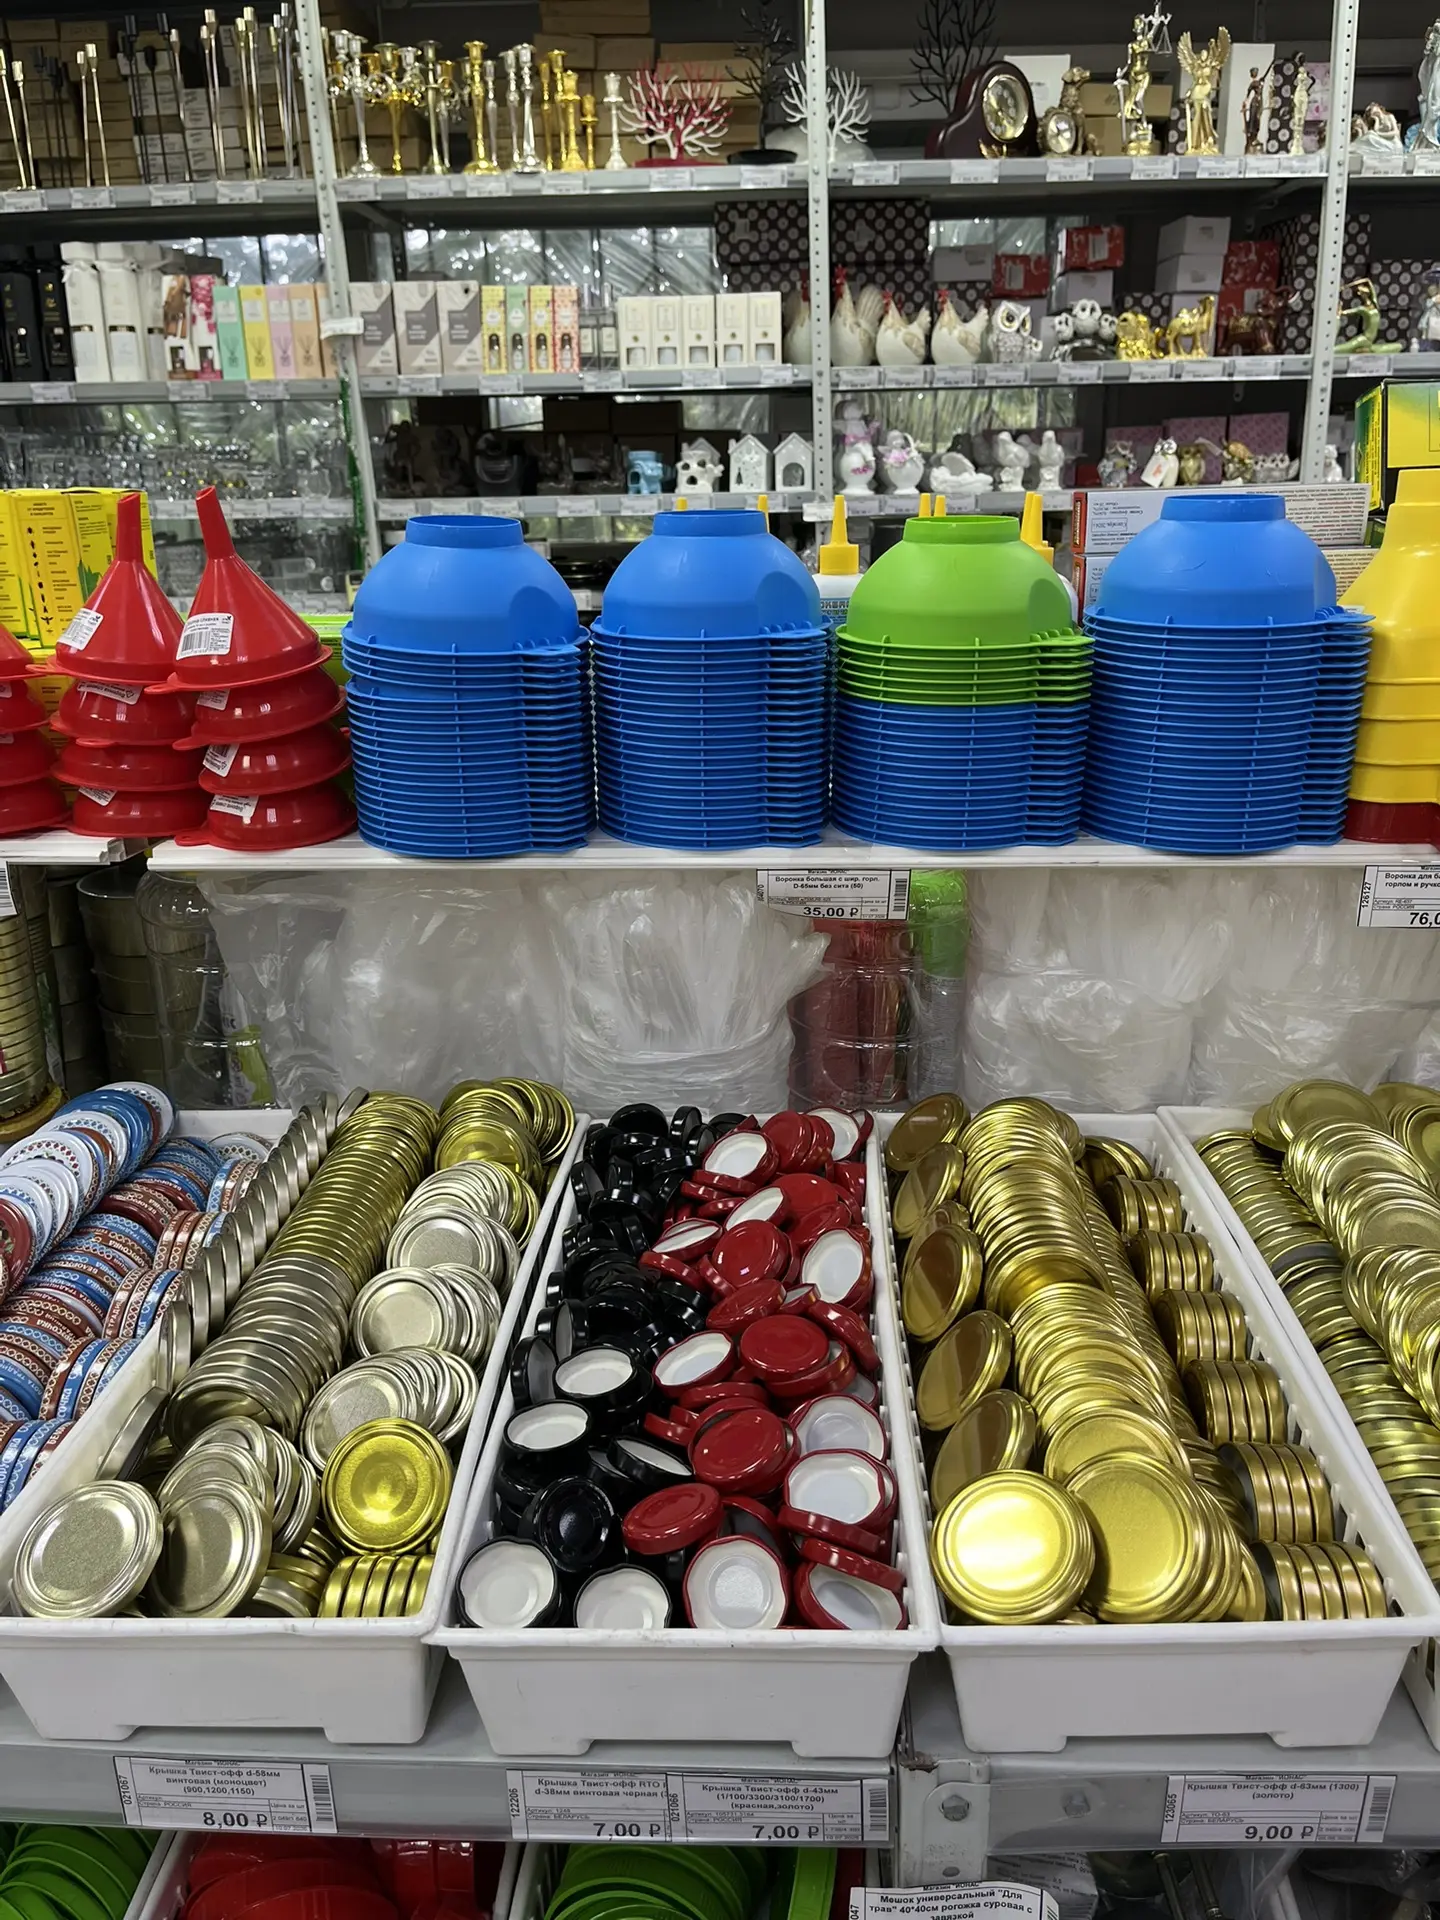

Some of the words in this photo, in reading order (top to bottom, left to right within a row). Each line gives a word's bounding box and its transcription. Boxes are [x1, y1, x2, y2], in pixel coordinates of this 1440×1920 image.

[775, 875, 805, 883] Воронка
[1361, 881, 1372, 909] 126127
[803, 906, 845, 918] 35,00
[78, 1292, 104, 1318] ТЕПЛОТА
[148, 1766, 187, 1775] Крышка
[190, 1768, 244, 1778] Твист-офф
[246, 1769, 281, 1778] d-58мм
[166, 1777, 211, 1785] винтовая
[213, 1778, 267, 1787] (моноцвет)
[538, 1778, 578, 1787] Крышка
[581, 1780, 637, 1789] Твист-офф
[702, 1784, 742, 1792] Крышка
[745, 1786, 800, 1794] Твист-офф
[803, 1786, 839, 1794] d-43мм
[1187, 1783, 1228, 1791] Крышка
[1231, 1783, 1288, 1791] Твист-офф
[1329, 1783, 1360, 1791] (1300)
[119, 1775, 132, 1805] 021067
[183, 1786, 255, 1796] (900,1200,1150)
[534, 1788, 570, 1796] d-38мм
[509, 1788, 520, 1820] 122206
[716, 1793, 825, 1803] (1/100/3300/3100/1700)
[669, 1792, 679, 1822] 021066
[731, 1802, 815, 1811] (красная,золото)
[1164, 1793, 1178, 1824] 123065
[203, 1811, 249, 1829] 8,00
[593, 1822, 641, 1841] 7,00
[752, 1825, 800, 1841] 7,00
[1244, 1825, 1293, 1842] 9,00
[880, 1895, 914, 1904] Мешок
[916, 1889, 996, 1904] универсальный
[998, 1890, 1023, 1900] "Для
[869, 1905, 898, 1914] трав"
[941, 1903, 981, 1914] рогожка
[983, 1900, 1025, 1913] суровая
